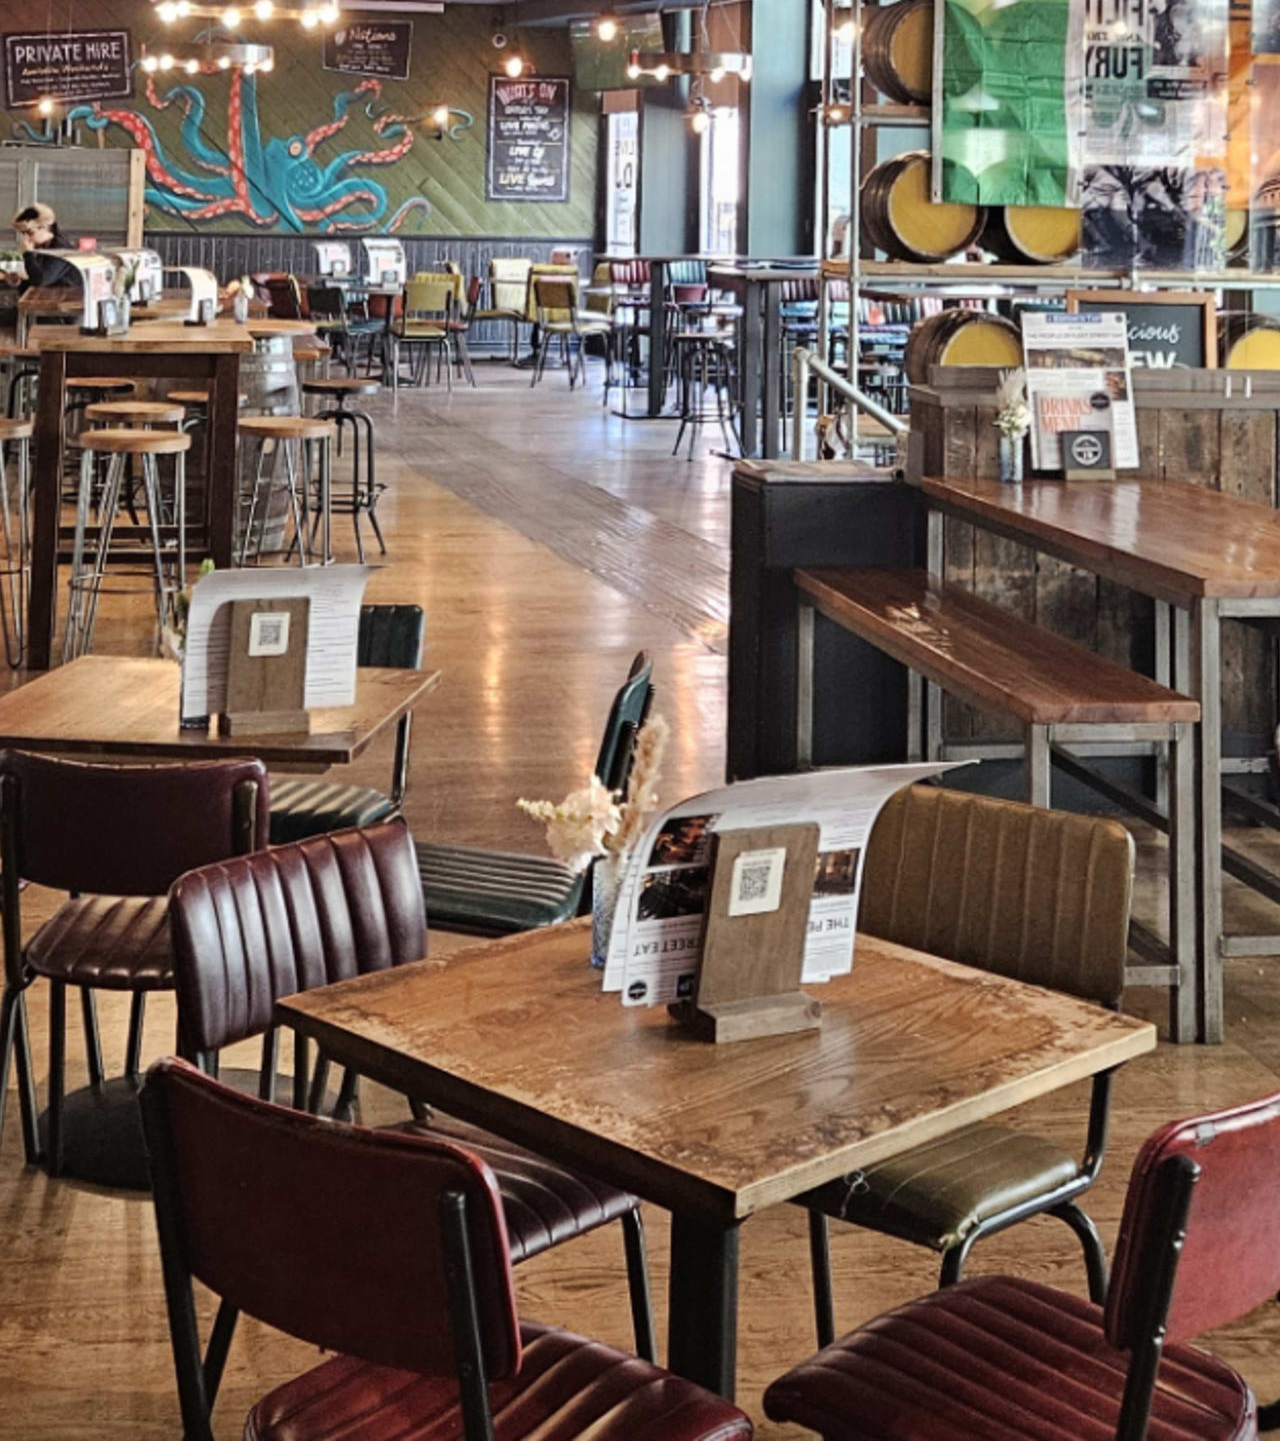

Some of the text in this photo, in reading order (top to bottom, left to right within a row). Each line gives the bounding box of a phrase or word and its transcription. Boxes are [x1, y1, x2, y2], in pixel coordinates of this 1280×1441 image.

[14, 41, 121, 63] PRIVATE HIRE
[1126, 321, 1182, 344] cious
[1040, 397, 1093, 415] DRINKS
[632, 938, 698, 957] REET EAT
